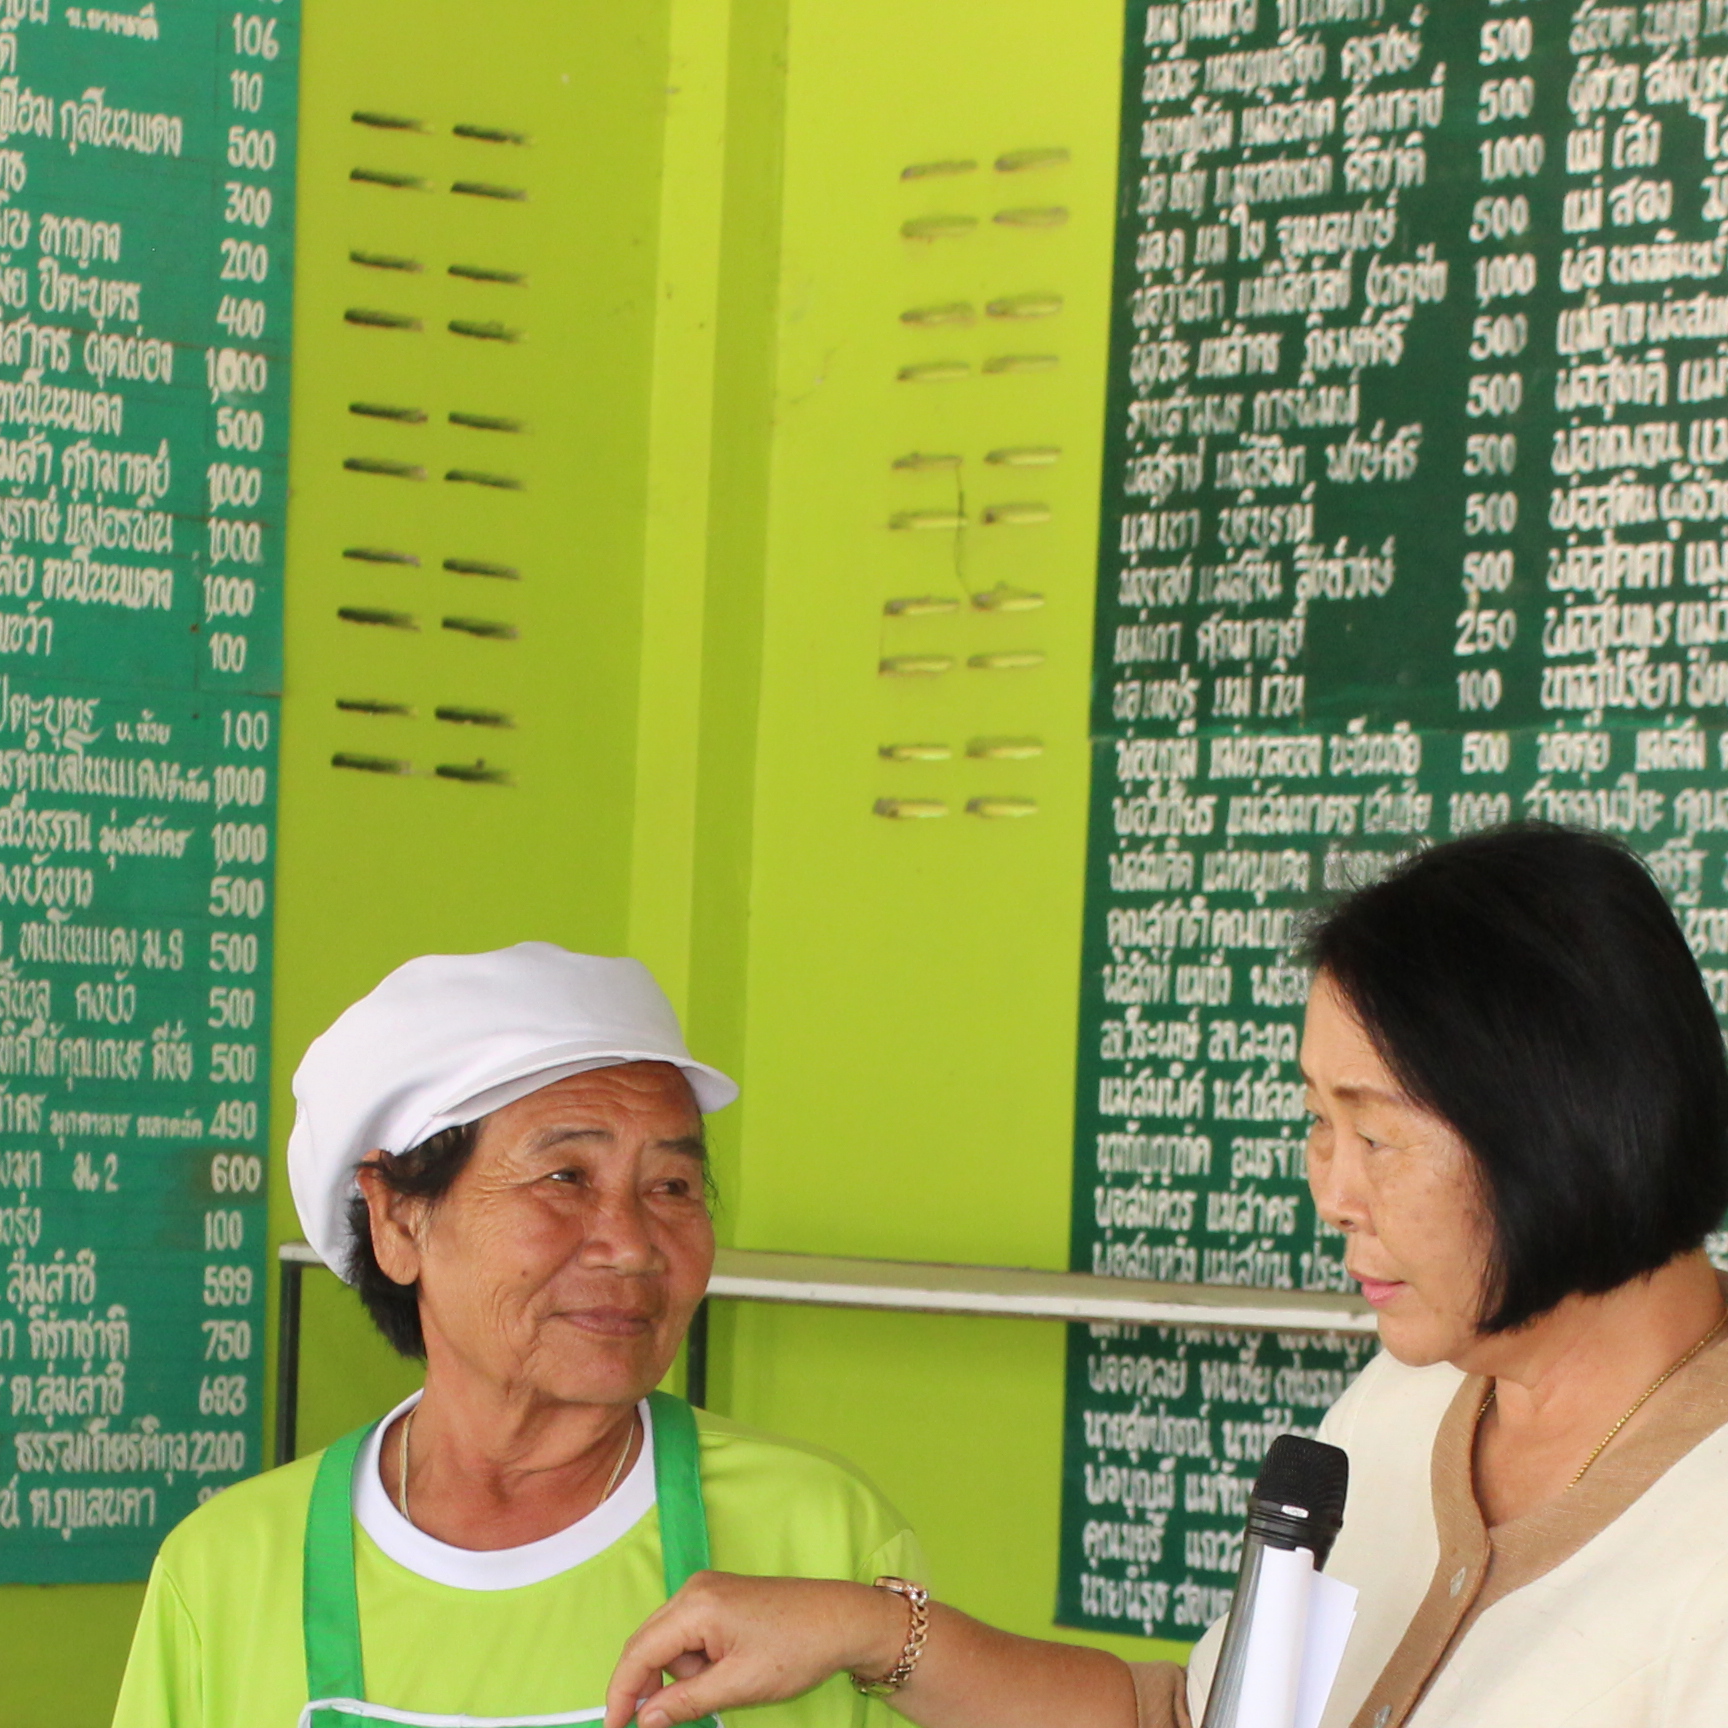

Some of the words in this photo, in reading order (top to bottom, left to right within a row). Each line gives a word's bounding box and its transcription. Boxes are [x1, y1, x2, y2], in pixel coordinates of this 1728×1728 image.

[230, 16, 281, 62] 106
[228, 68, 265, 115] 110
[224, 180, 273, 229] 300
[215, 294, 267, 339] 400
[215, 405, 265, 452] 500
[208, 875, 266, 919] 500
[208, 931, 259, 974] 500
[207, 985, 257, 1030] 500
[208, 1042, 258, 1084] 500
[208, 1099, 258, 1141] 490
[209, 1152, 261, 1194] 600
[204, 1209, 244, 1251] 100
[202, 1264, 254, 1307] 599
[200, 1319, 252, 1363] 750
